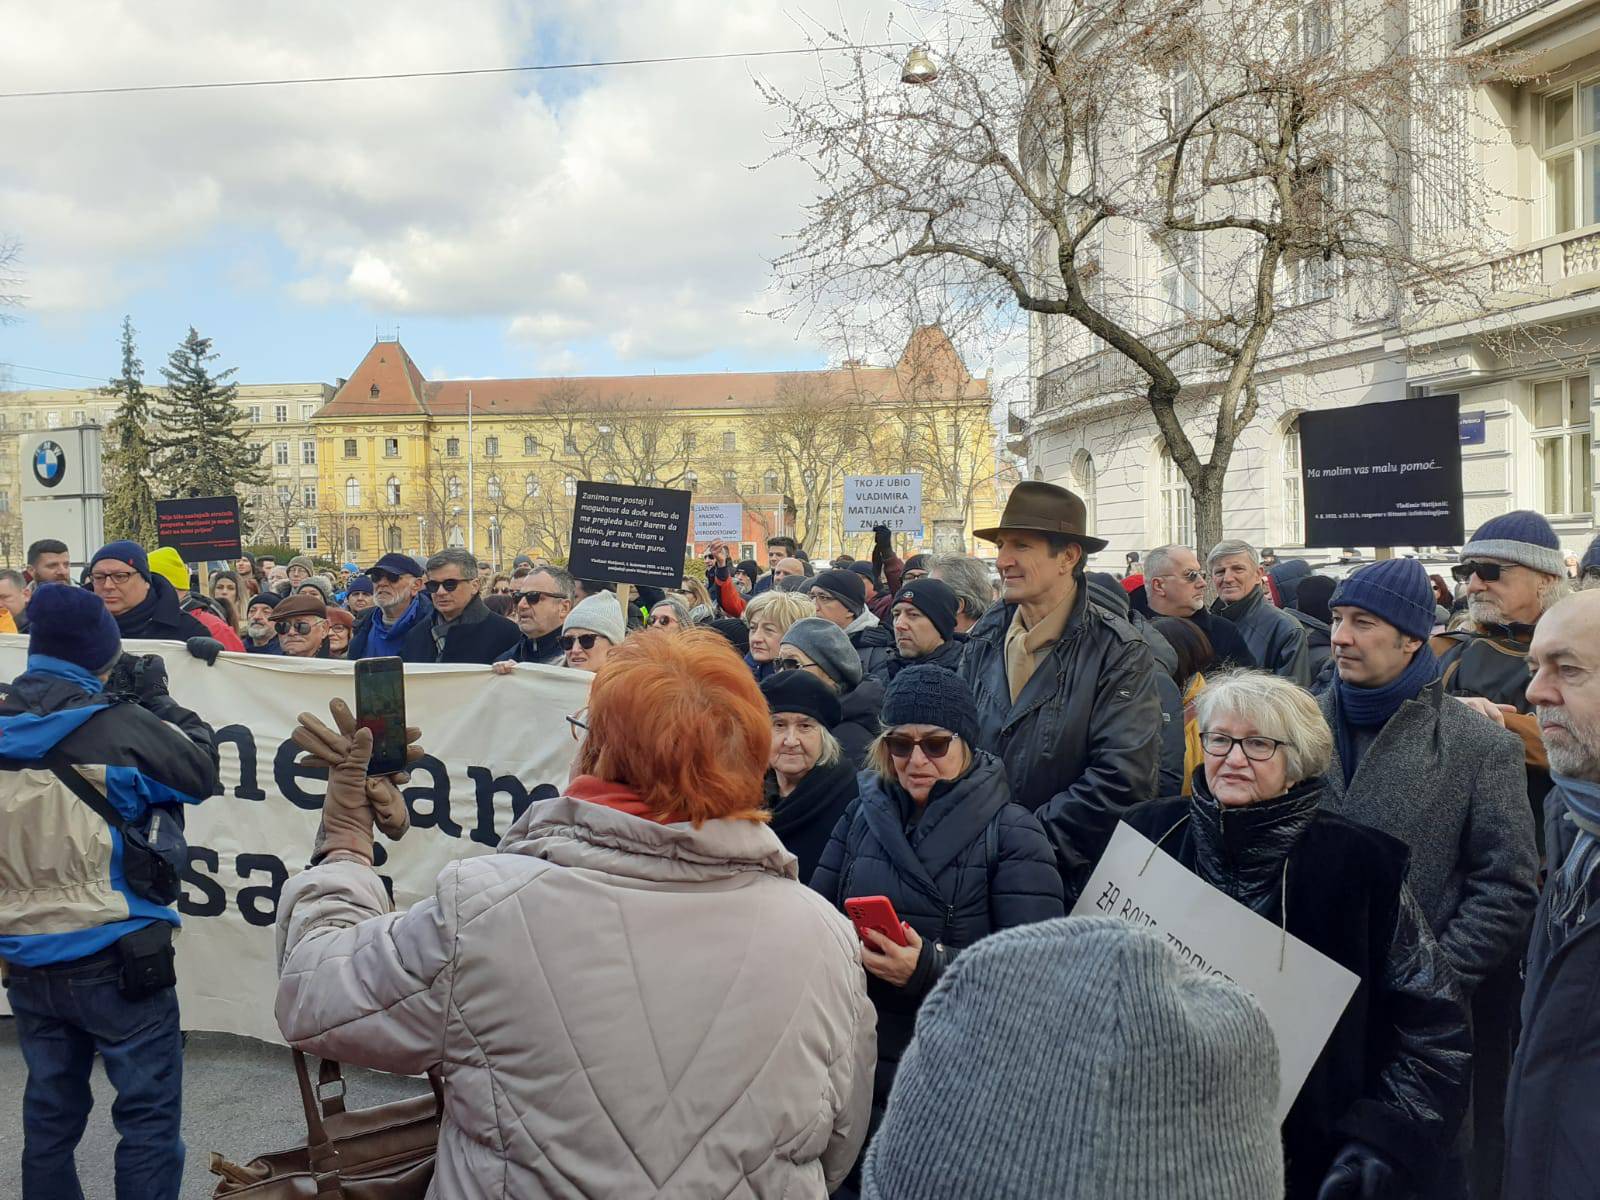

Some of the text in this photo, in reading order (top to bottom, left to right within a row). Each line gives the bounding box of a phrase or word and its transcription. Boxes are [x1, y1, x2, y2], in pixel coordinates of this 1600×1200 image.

[1308, 468, 1320, 478] Ma
[1323, 465, 1351, 476] molim
[1354, 466, 1368, 475] vas
[1372, 462, 1397, 473] malu
[854, 478, 911, 488] TKO JE UBIO
[582, 493, 609, 501] Zanima
[623, 497, 646, 506] postoji
[856, 492, 908, 501] VLADIMIRA
[581, 505, 619, 514] mogućnost
[632, 509, 648, 517] dođe
[650, 510, 668, 518] netko
[848, 504, 916, 514] MATIJANIĆA ?!
[592, 517, 622, 526] pregleda
[644, 522, 666, 530] Barem
[860, 519, 904, 528] ZNA SE !?
[579, 527, 604, 536] vidimo,
[636, 532, 656, 540] nisam
[578, 538, 599, 547] stanju
[621, 542, 645, 551] krećem
[1096, 882, 1120, 915] ZA
